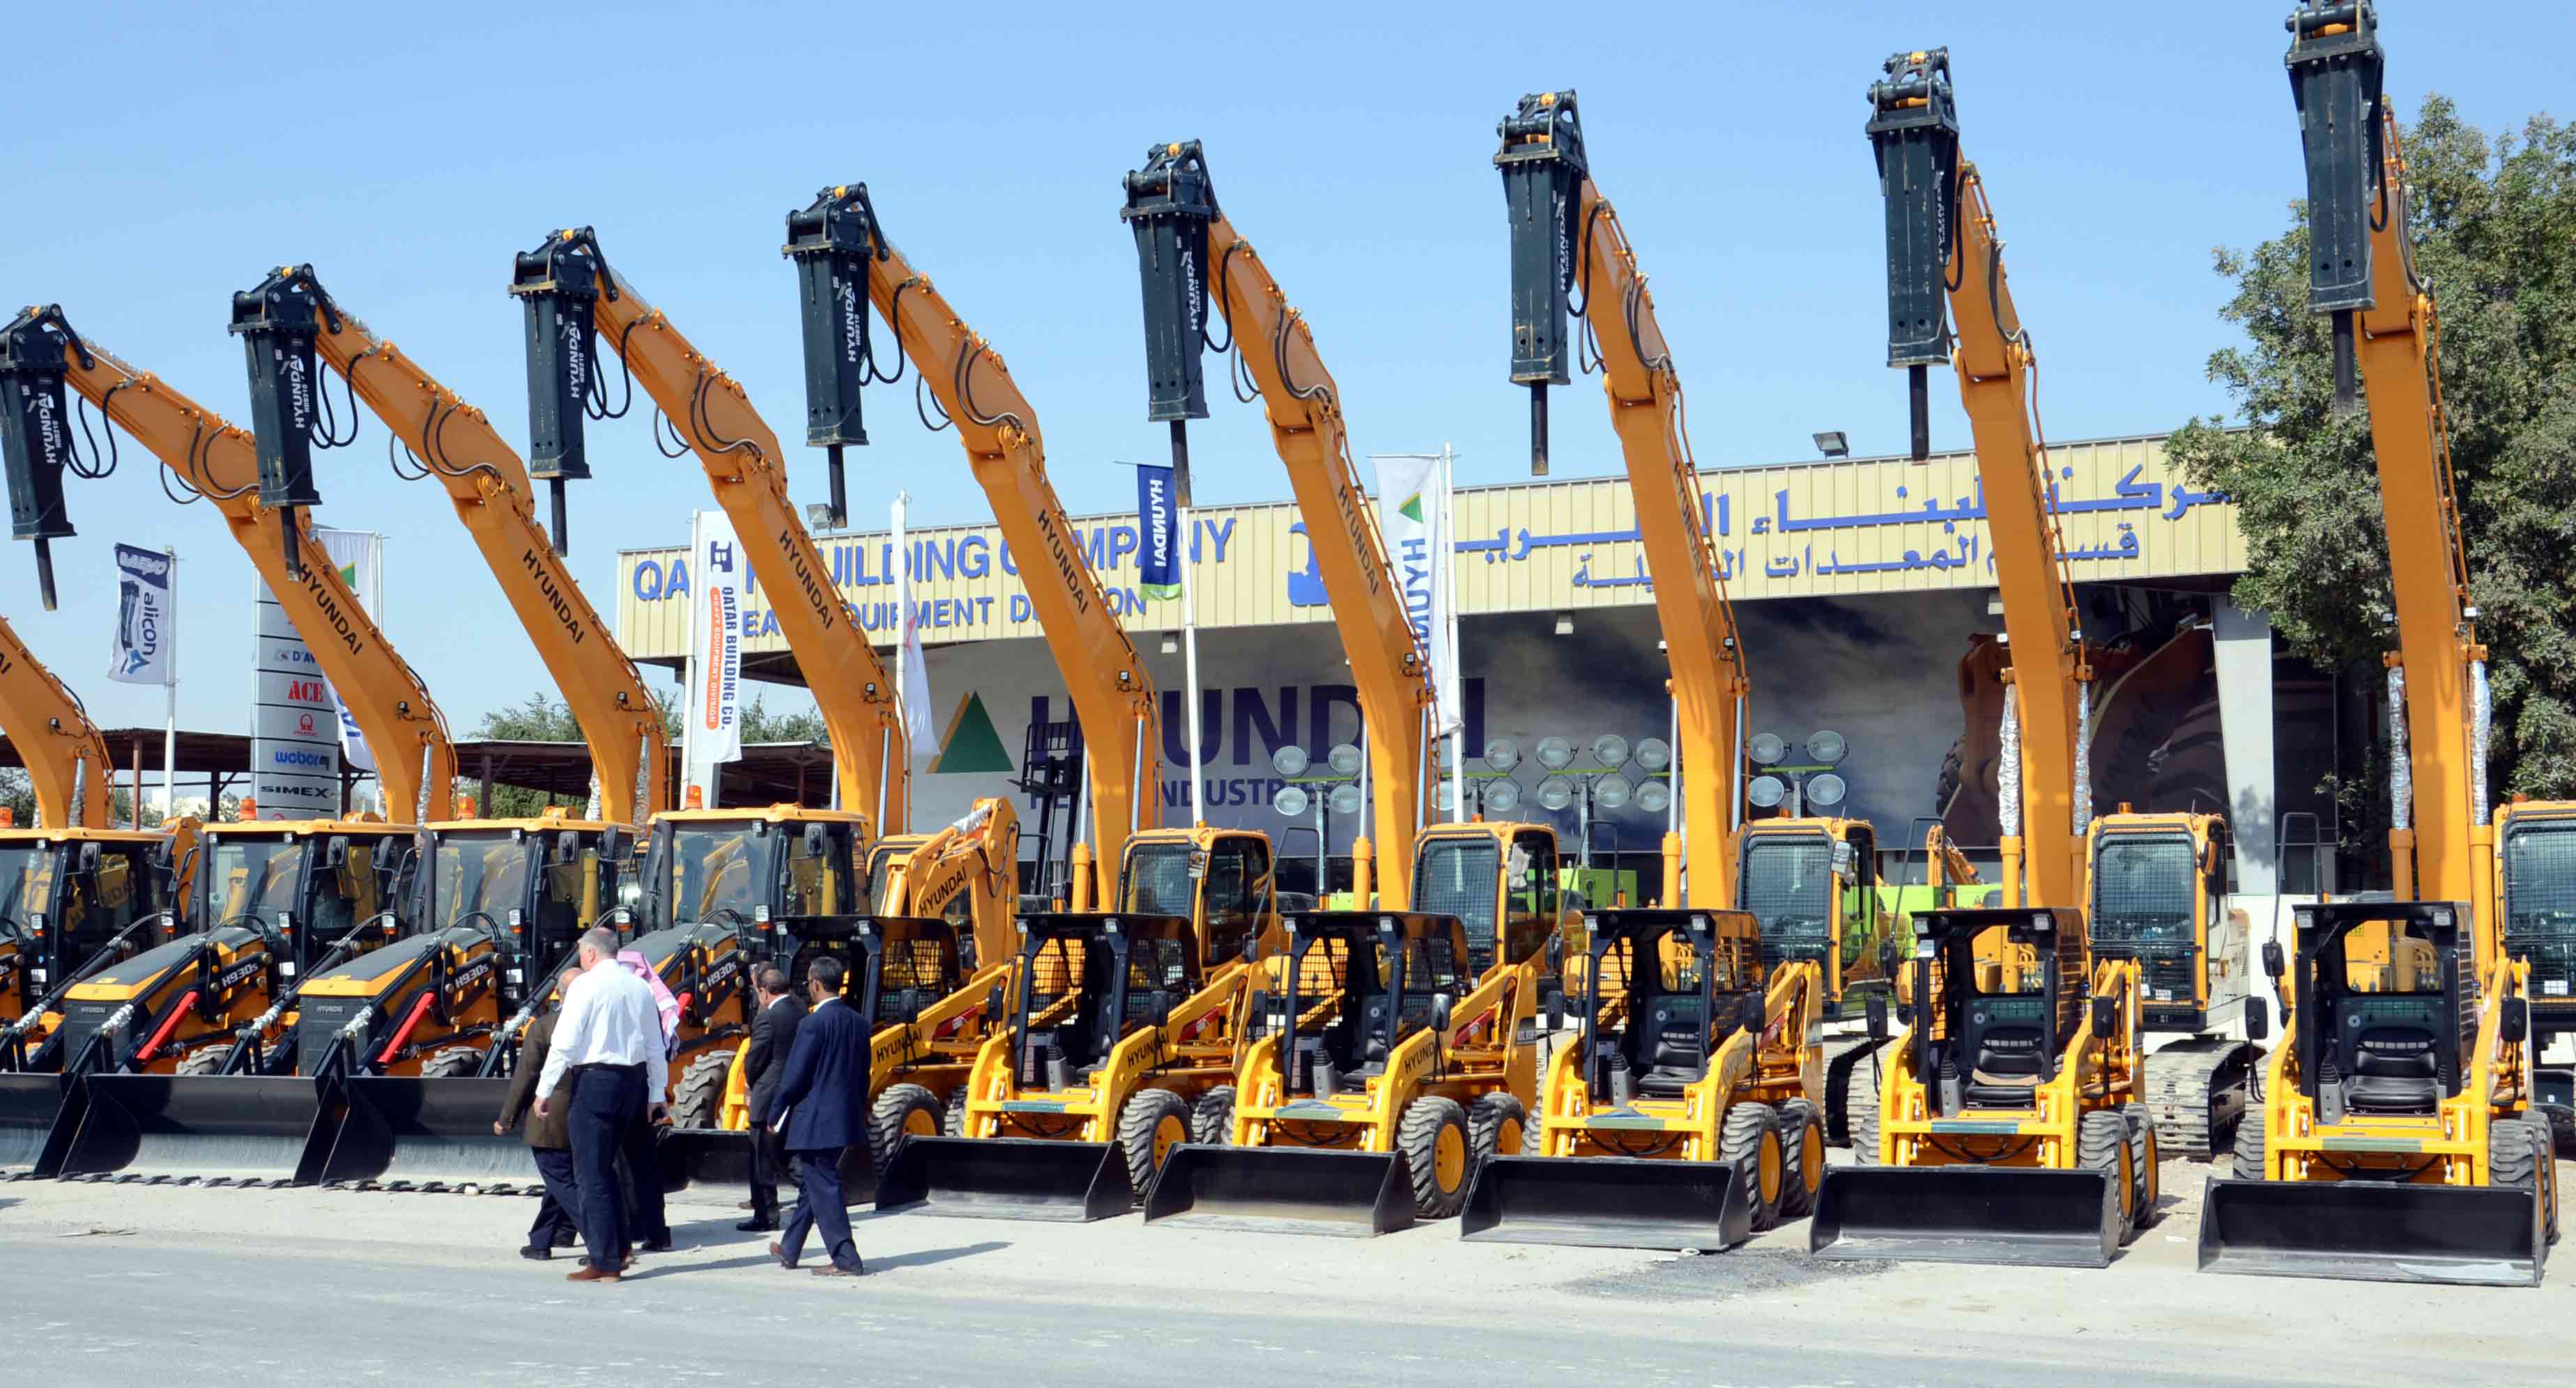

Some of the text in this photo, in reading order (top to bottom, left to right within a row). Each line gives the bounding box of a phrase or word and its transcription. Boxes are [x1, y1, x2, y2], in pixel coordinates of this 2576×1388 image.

[845, 281, 857, 362] HYUNDAI
[289, 354, 305, 429] HYUNDAI
[569, 321, 580, 399] HYUNDAI
[38, 392, 57, 463] HYUNDAI
[1037, 509, 1089, 615] HYUNDAI
[1338, 484, 1379, 596] HYUNDAI
[300, 562, 363, 656] HYUNDAI
[523, 547, 585, 645] HYUNDAI
[721, 587, 737, 630] QATAR
[779, 529, 834, 631] HYUNDAI
[141, 592, 160, 656] alicon
[288, 681, 324, 703] ACE
[722, 635, 737, 702] BUILDING
[721, 706, 734, 730] CO.
[261, 785, 330, 799] SIMEX
[919, 865, 967, 917] HYUNDAI
[1126, 1031, 1170, 1067] HYUNAI
[1404, 1042, 1436, 1074] HYUND
